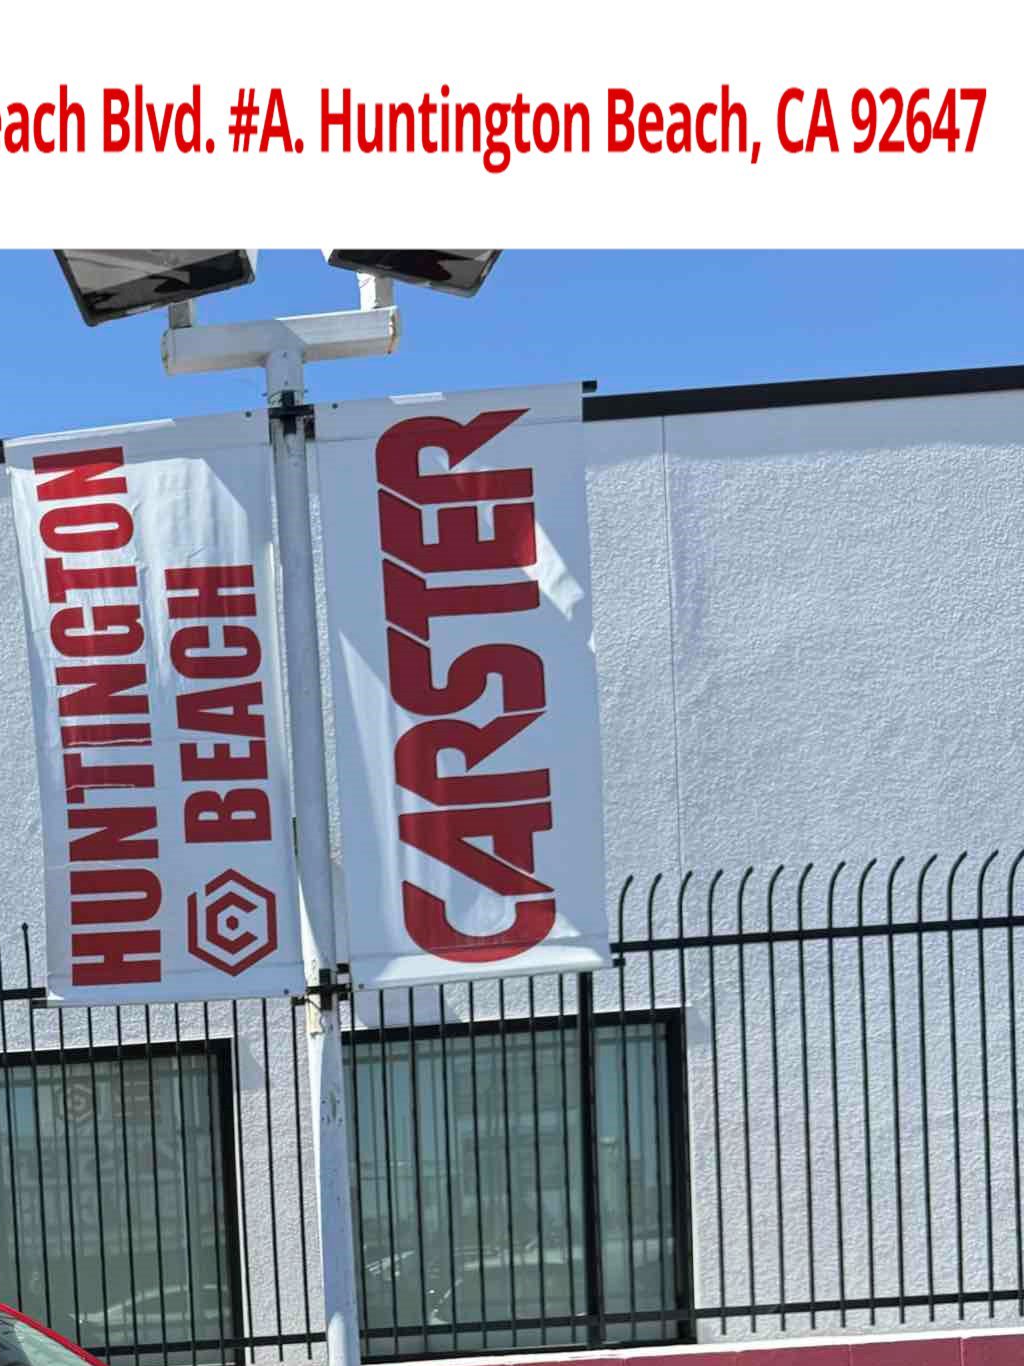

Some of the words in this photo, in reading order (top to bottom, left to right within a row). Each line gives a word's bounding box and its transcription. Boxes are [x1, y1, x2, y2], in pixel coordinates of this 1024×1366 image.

[32, 446, 163, 986] HUNTINGTON
[163, 564, 273, 844] BEACH
[374, 408, 556, 964] CARSTER
